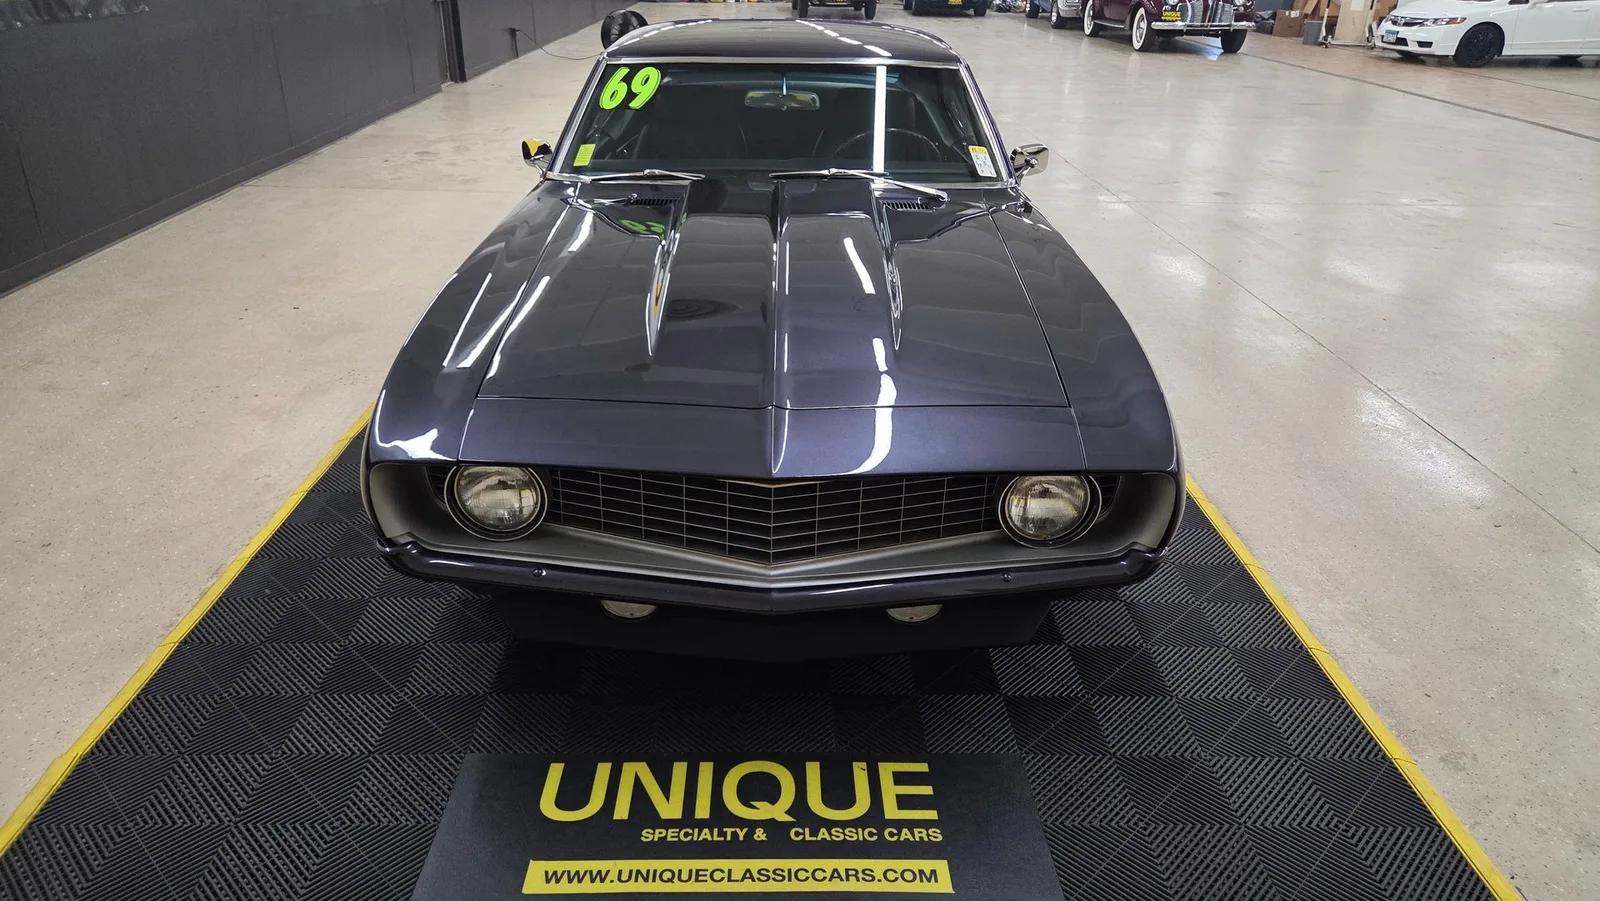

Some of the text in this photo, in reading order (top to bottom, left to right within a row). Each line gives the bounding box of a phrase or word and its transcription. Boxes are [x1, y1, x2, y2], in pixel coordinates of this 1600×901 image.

[600, 66, 661, 110] 69
[539, 760, 939, 822] UNIQUE
[640, 827, 943, 841] SPECIALTY & CLASSIC CARS
[543, 868, 938, 884] WWW.UNIQUECLASSICCARS.COM
